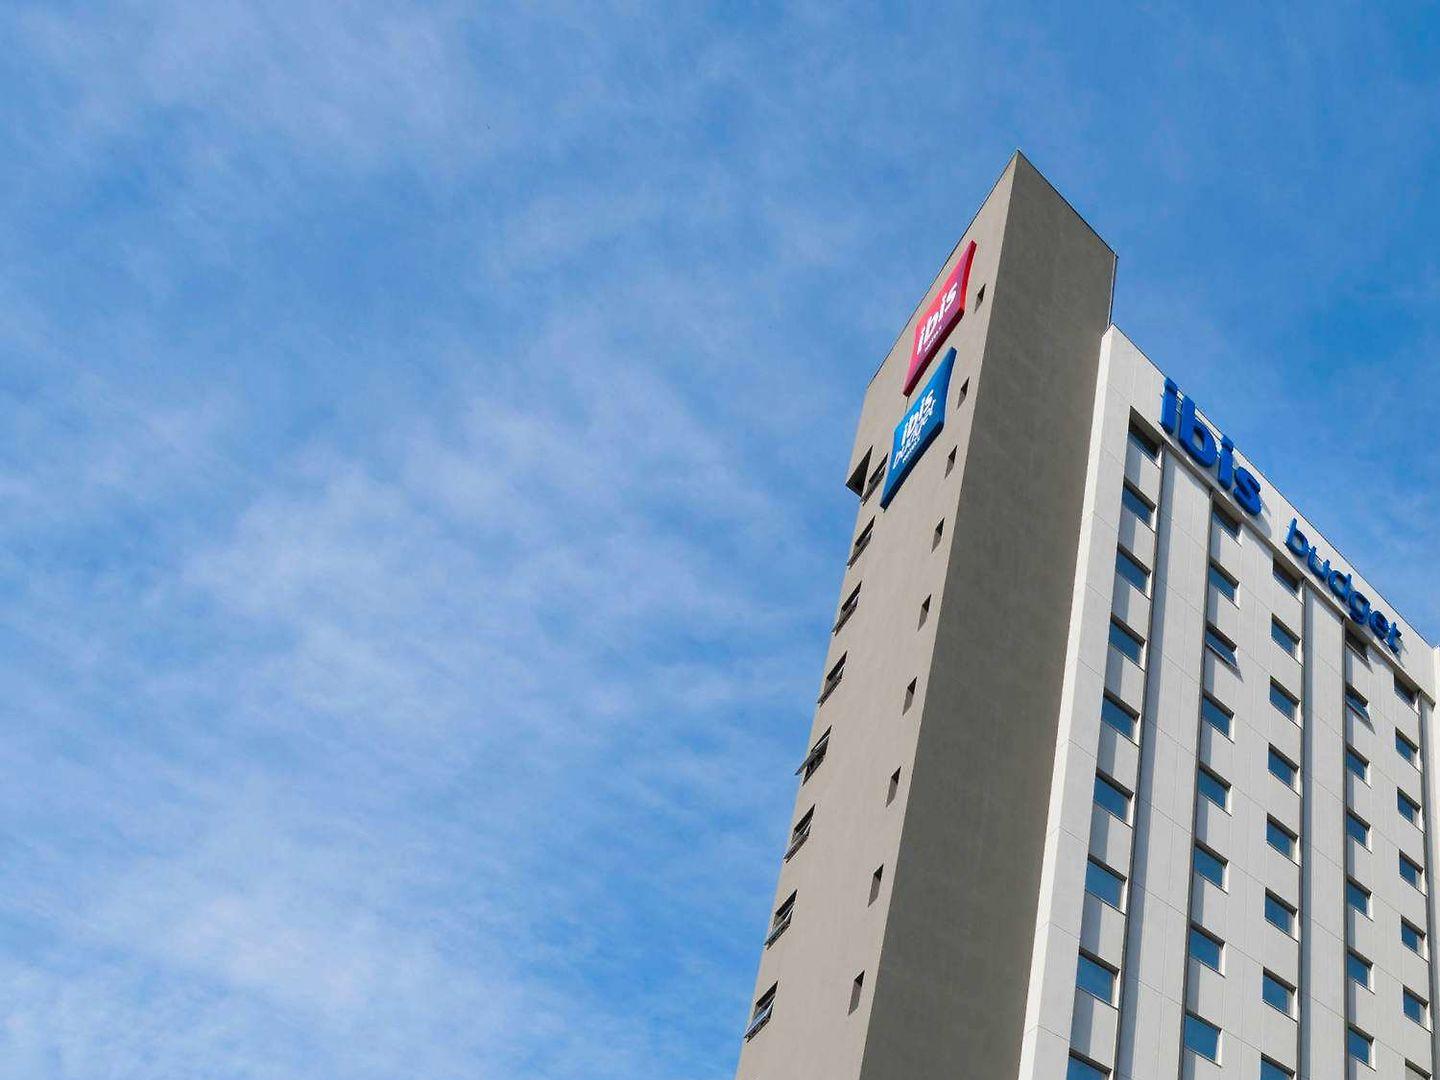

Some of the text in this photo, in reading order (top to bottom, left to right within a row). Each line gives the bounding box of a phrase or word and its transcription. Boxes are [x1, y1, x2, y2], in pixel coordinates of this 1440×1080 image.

[917, 282, 957, 355] ibis
[1159, 377, 1402, 653] ibis budget
